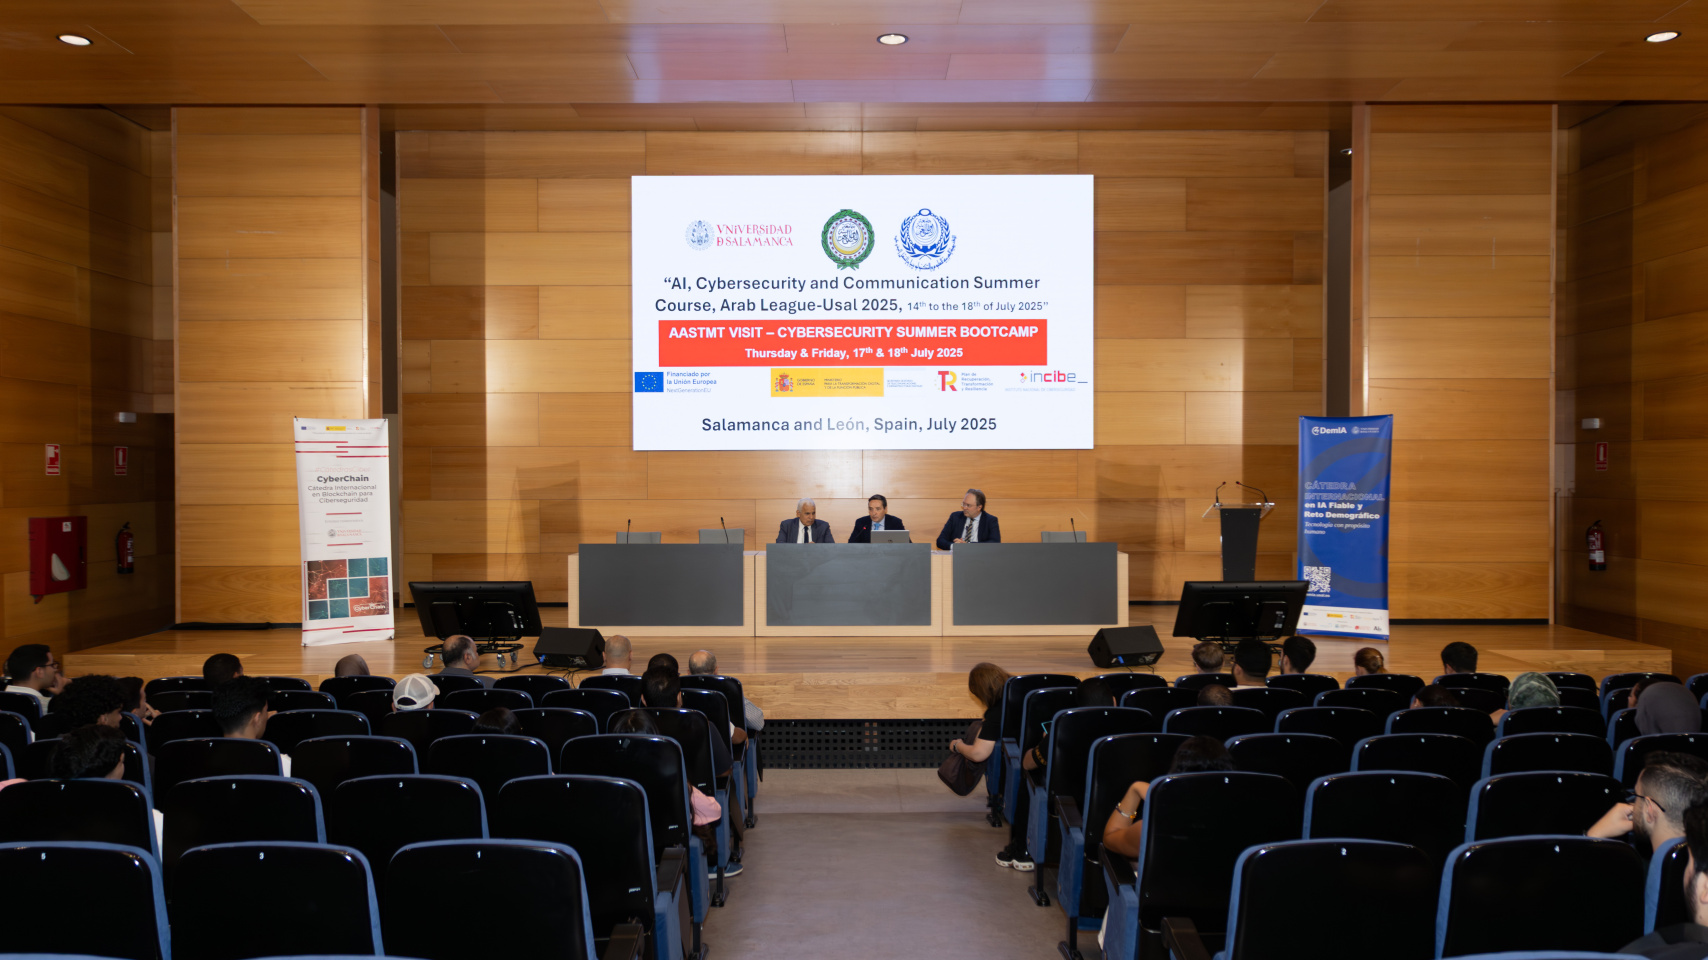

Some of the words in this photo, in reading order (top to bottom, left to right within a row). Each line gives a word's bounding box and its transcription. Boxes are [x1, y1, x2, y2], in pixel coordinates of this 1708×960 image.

[664, 277, 692, 292] “AI,
[696, 277, 806, 292] Cybersecurity
[810, 277, 839, 290] and
[843, 276, 969, 289] Communication
[973, 276, 1041, 289] Summer
[655, 299, 716, 313] Course,
[720, 298, 756, 311] Arab
[760, 298, 858, 315] League-Usal
[861, 298, 903, 313] 2025,
[907, 302, 926, 311] 14th
[928, 302, 940, 311] to
[942, 302, 959, 311] the
[961, 301, 981, 311] 18th
[983, 302, 994, 311] of
[995, 302, 1016, 313] July
[1018, 302, 1049, 311] 2025”
[669, 327, 725, 338] AASTMT
[729, 327, 763, 338] VISIT
[777, 326, 893, 338] CYBERSECURITY
[896, 326, 957, 338] SUMMER
[960, 326, 1039, 338] BOOTCAMP
[745, 348, 798, 360] Thursday
[800, 348, 809, 358] &
[812, 348, 850, 360] Friday,
[853, 347, 873, 358] 17th
[876, 348, 885, 358] &
[888, 347, 908, 358] 18th
[911, 348, 935, 360] July
[937, 348, 963, 358] 2025
[693, 378, 717, 386] Europea
[702, 418, 790, 431] Salamanca
[794, 418, 823, 431] and
[827, 417, 870, 432] León,
[874, 418, 923, 433] Spain,
[926, 417, 957, 433] July
[961, 418, 997, 430] 2025
[317, 475, 369, 484] CyberChain
[1304, 481, 1356, 490] CÁTEDRA
[1304, 492, 1385, 501] INTERNACIONAL
[1325, 511, 1380, 520] Demográfico
